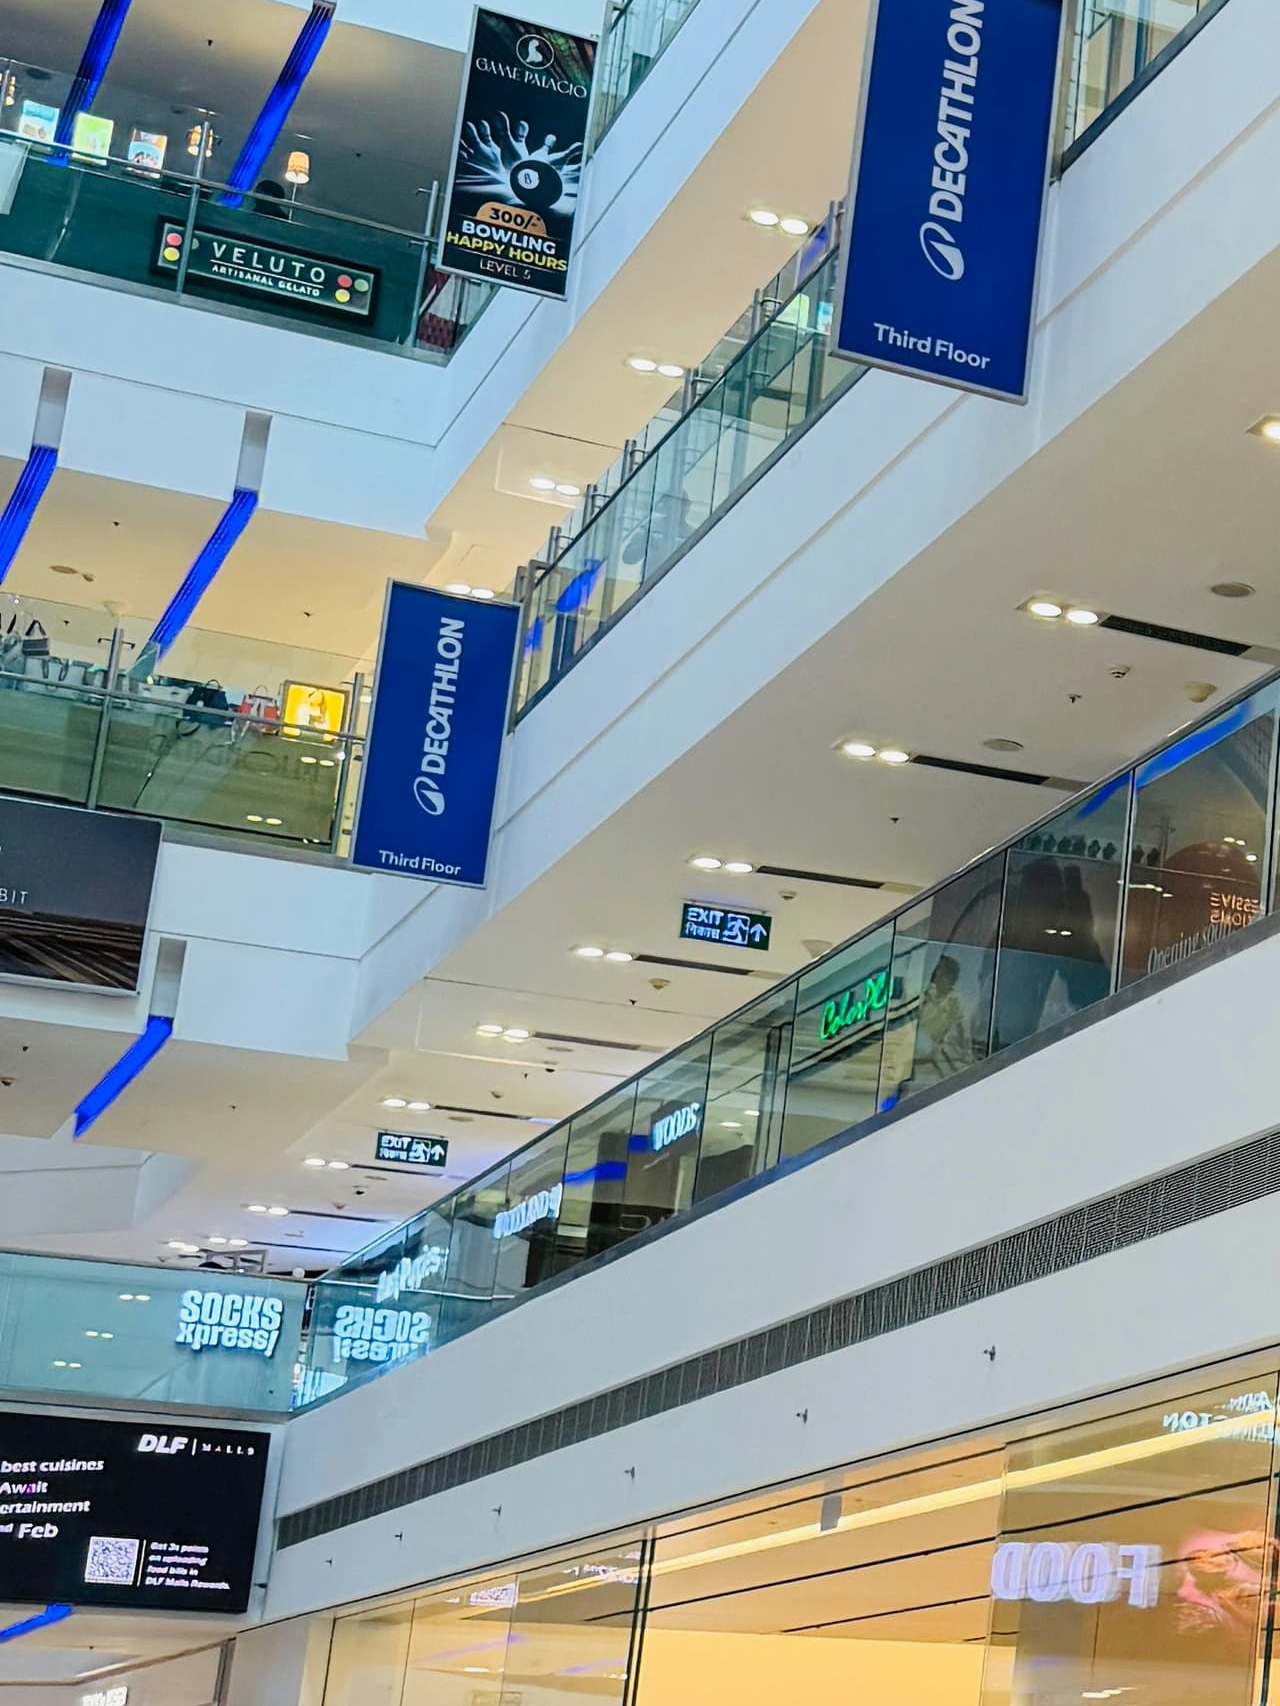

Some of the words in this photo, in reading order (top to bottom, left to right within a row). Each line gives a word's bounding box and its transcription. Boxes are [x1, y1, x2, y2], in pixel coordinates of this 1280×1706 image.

[475, 57, 521, 82] GAME
[524, 70, 587, 99] PALACIO
[447, 231, 505, 258] HAPPY
[509, 245, 568, 271] HOURS
[461, 220, 556, 255] BOWLING
[212, 242, 326, 283] VELUTO
[479, 259, 518, 278] LEVEL
[212, 264, 274, 287] ARTISANAL
[278, 280, 320, 297] GELATO
[873, 322, 932, 355] Third
[935, 340, 990, 370] Floor
[420, 616, 465, 775] DECATHLON
[378, 850, 420, 871] Third
[421, 857, 462, 875] Floor
[687, 907, 724, 926] EXIT
[381, 1135, 412, 1149] EXIT
[180, 1290, 284, 1332] SOCKS
[175, 1322, 280, 1358] xpress!
[137, 1434, 188, 1454] DLF
[0, 1460, 36, 1473] best
[39, 1459, 104, 1472] cuisines
[0, 1481, 48, 1494] Await
[17, 1523, 58, 1539] Feb
